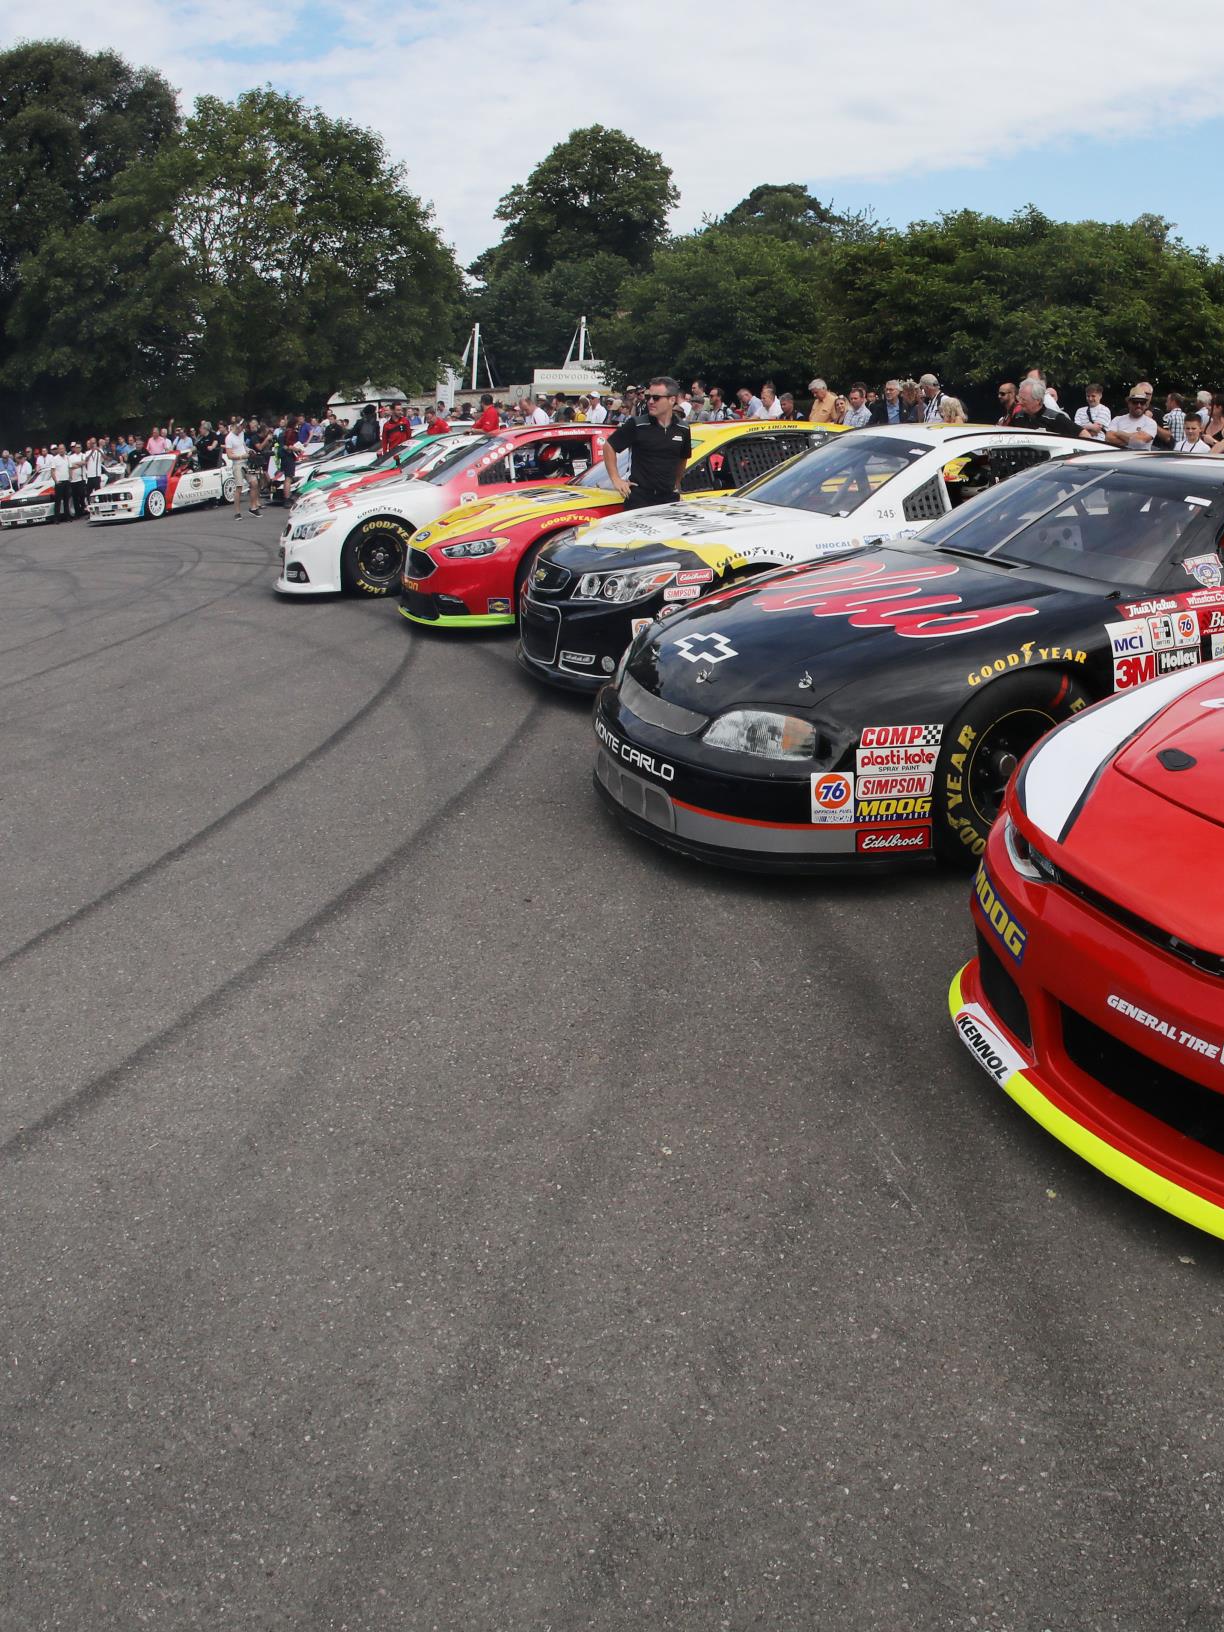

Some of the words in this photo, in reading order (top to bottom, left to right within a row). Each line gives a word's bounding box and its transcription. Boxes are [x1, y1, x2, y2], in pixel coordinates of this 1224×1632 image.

[540, 372, 588, 381] GOODWOOD
[176, 489, 220, 501] WARSTEINER
[877, 509, 896, 519] 245
[815, 541, 851, 550] UNOCAL
[679, 572, 711, 582] Edelbrock
[666, 587, 697, 598] SIMPSON
[1186, 595, 1216, 605] Winston
[1180, 621, 1191, 633] 76
[1113, 635, 1144, 653] MCI
[1161, 650, 1198, 669] Holley
[1115, 654, 1155, 689] 3M
[861, 726, 923, 747] COMP
[595, 716, 619, 754] MONTE
[621, 743, 675, 782] CARLO
[860, 748, 936, 768] plasti-kote
[820, 781, 847, 802] 76
[862, 777, 927, 796] SIMPSON
[856, 797, 933, 817] MOOG
[859, 814, 897, 822] CHASSIS
[862, 833, 924, 849] Edelbrock
[1107, 994, 1177, 1040] GENERAL
[1178, 1030, 1221, 1059] TIRE
[957, 1015, 1008, 1080] KENNOL
